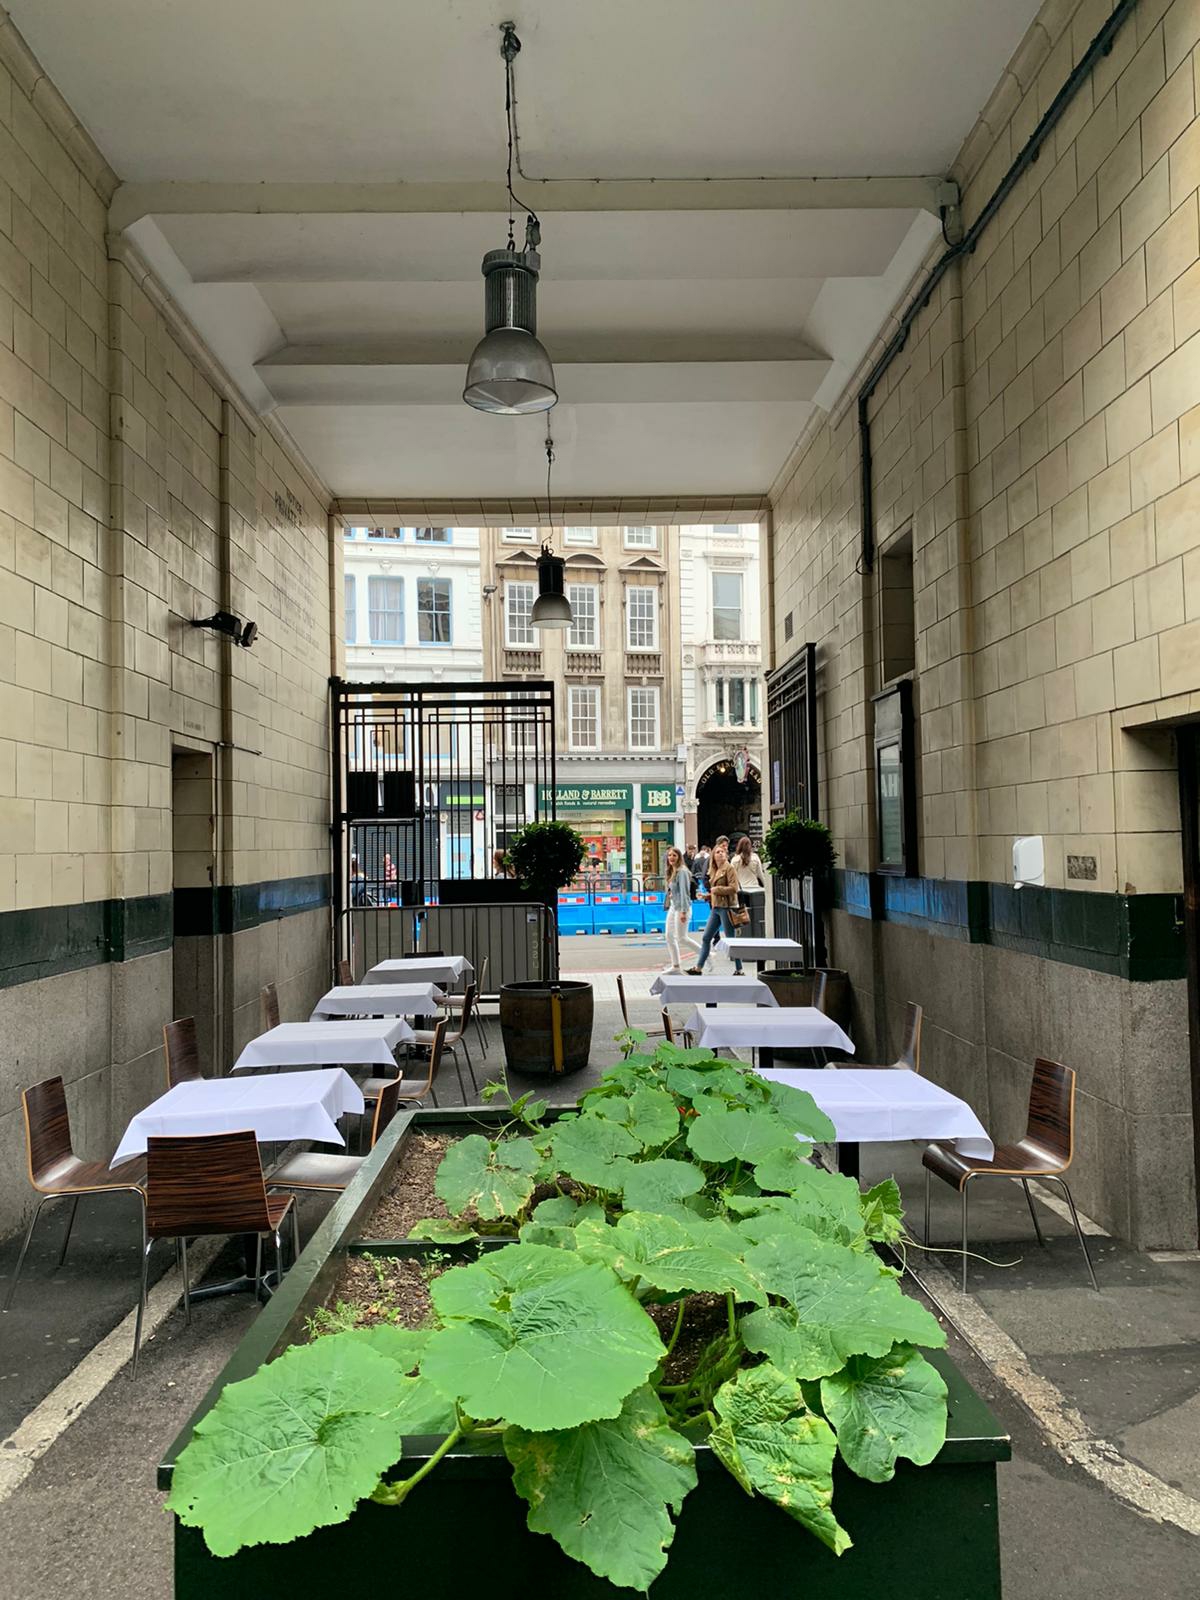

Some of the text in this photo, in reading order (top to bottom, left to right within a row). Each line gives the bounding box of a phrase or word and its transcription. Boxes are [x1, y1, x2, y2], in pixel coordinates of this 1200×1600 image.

[541, 789, 628, 800] HOLAND & BARRETT
